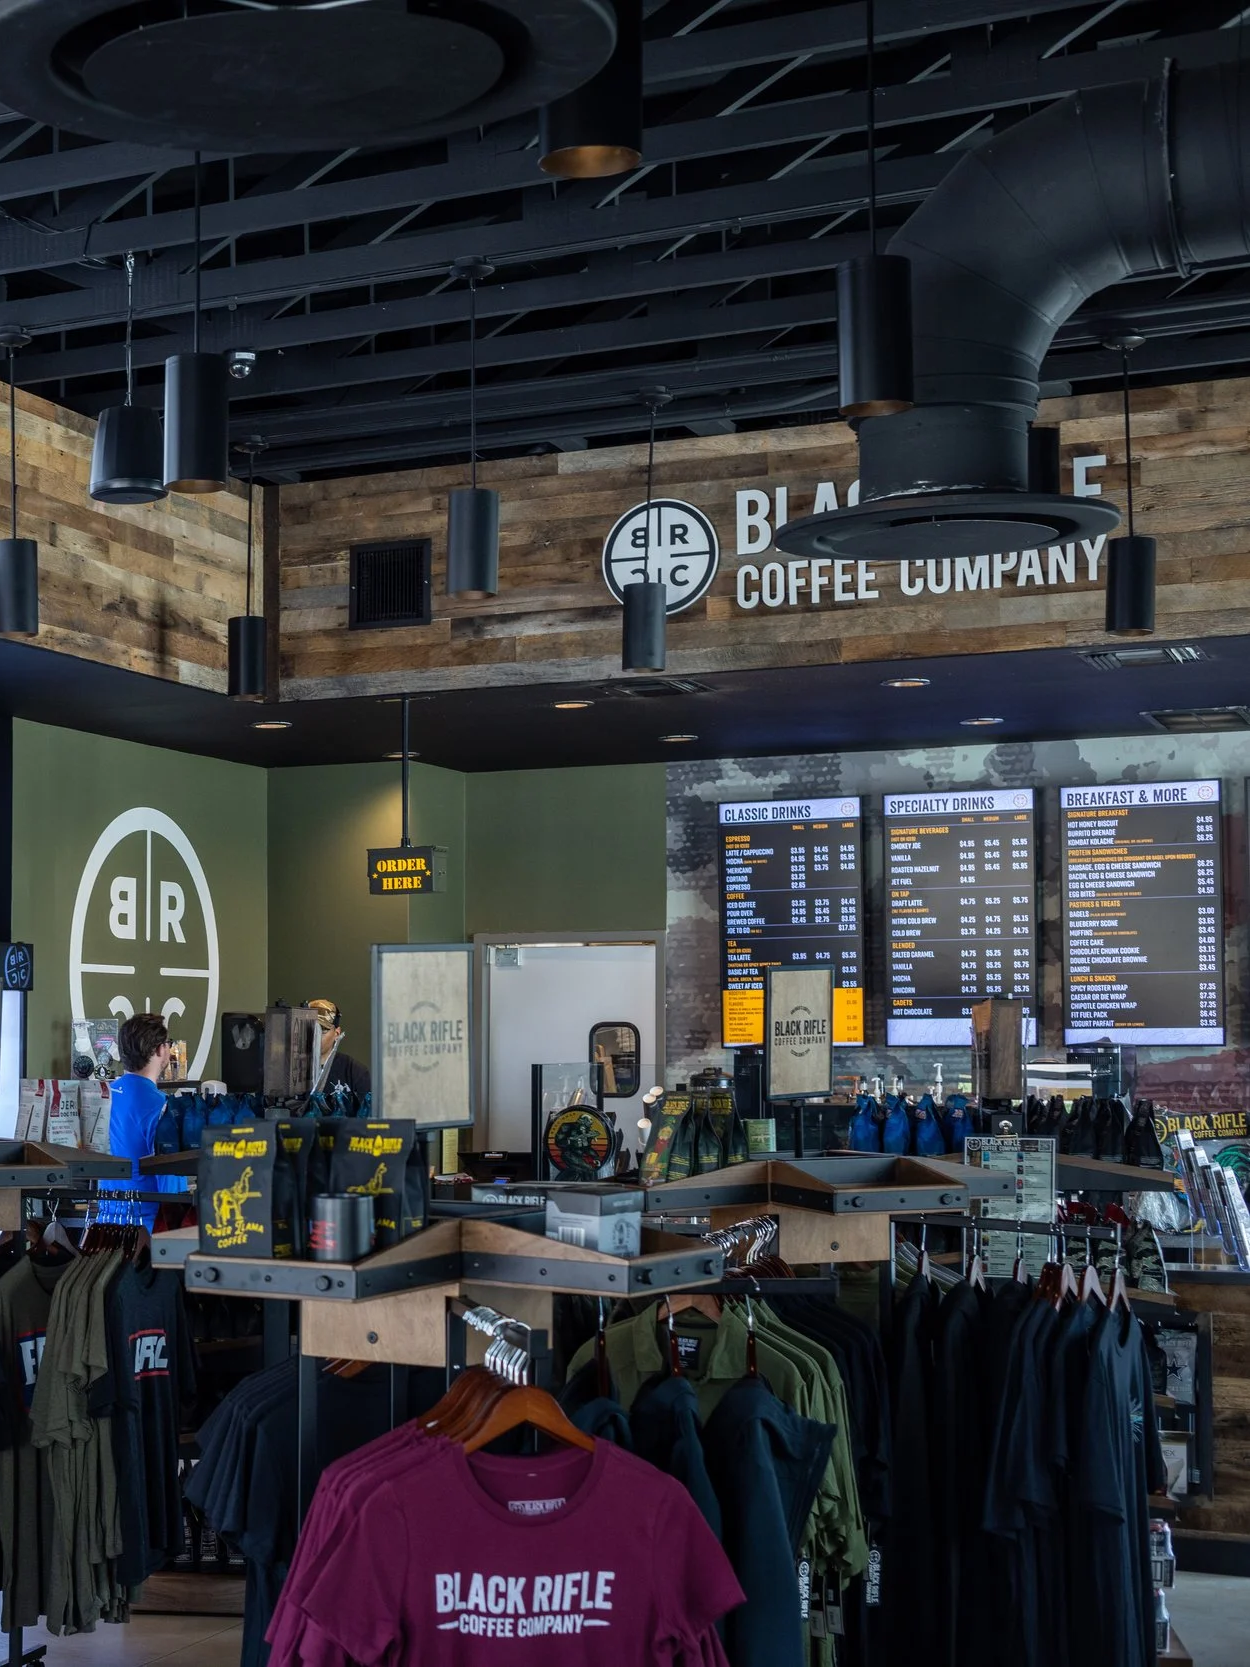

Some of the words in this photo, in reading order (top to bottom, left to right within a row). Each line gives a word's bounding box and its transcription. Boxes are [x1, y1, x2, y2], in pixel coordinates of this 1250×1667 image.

[736, 558, 880, 610] COFFEE
[900, 533, 1108, 597] COMPANY
[890, 799, 949, 813] SPECIALTY
[952, 796, 994, 811] DRINKS
[1067, 790, 1134, 806] BREAKFAST
[1138, 789, 1148, 803] &
[1153, 788, 1187, 802] MORE
[724, 808, 768, 822] CLASSIC
[771, 805, 811, 819] DRINKS
[1098, 809, 1128, 817] BREAKFAST
[1092, 848, 1127, 856] SANDWICHES
[376, 857, 427, 873] ORDER
[1111, 862, 1131, 870] CHEESE
[1132, 861, 1161, 869] SANDWICH
[382, 876, 422, 891] HERE
[387, 1021, 426, 1044] BLACK
[430, 1019, 463, 1042] RIFLE
[774, 1020, 801, 1037] BLACK
[803, 1019, 827, 1035] RIFLE
[774, 1037, 797, 1046] COFFEE
[799, 1036, 827, 1045] COMPANY
[423, 1043, 463, 1056] COMPANY
[1166, 1115, 1210, 1132] BLACK
[1212, 1113, 1247, 1129] RIFLE
[1193, 1130, 1216, 1139] COFFEE
[1217, 1128, 1248, 1137] COMPANY
[499, 1195, 522, 1204] BLACK
[217, 1235, 248, 1249] COFFEE
[435, 1572, 526, 1614] BLACK
[532, 1571, 615, 1614] RIFLE
[459, 1614, 514, 1637] COFFEE
[517, 1614, 584, 1638] COMPANY
